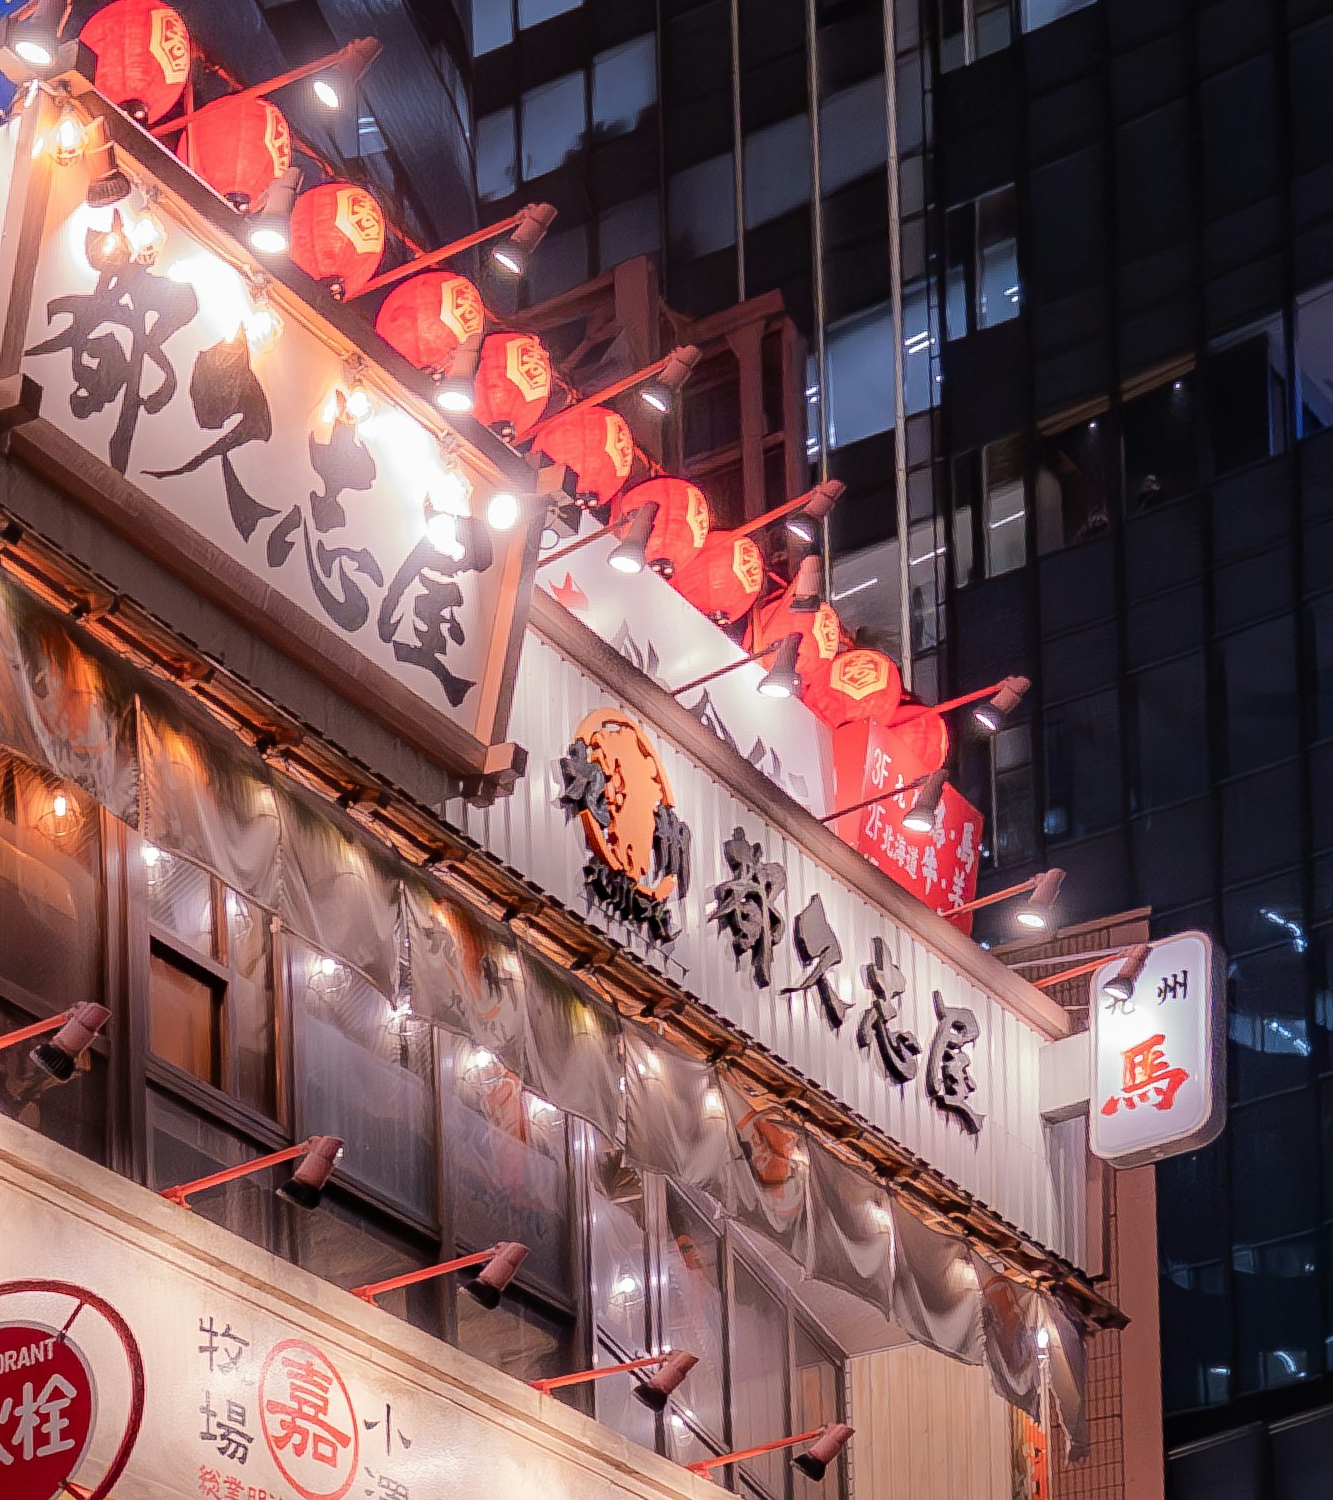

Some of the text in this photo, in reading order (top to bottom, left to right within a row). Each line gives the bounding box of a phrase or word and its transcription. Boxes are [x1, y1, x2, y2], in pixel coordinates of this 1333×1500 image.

[866, 803, 885, 841] 2F
[883, 824, 919, 879] 北海道
[1101, 1032, 1191, 1117] 馬
[197, 1315, 255, 1465] 牧場
[266, 1355, 351, 1469] 嘉
